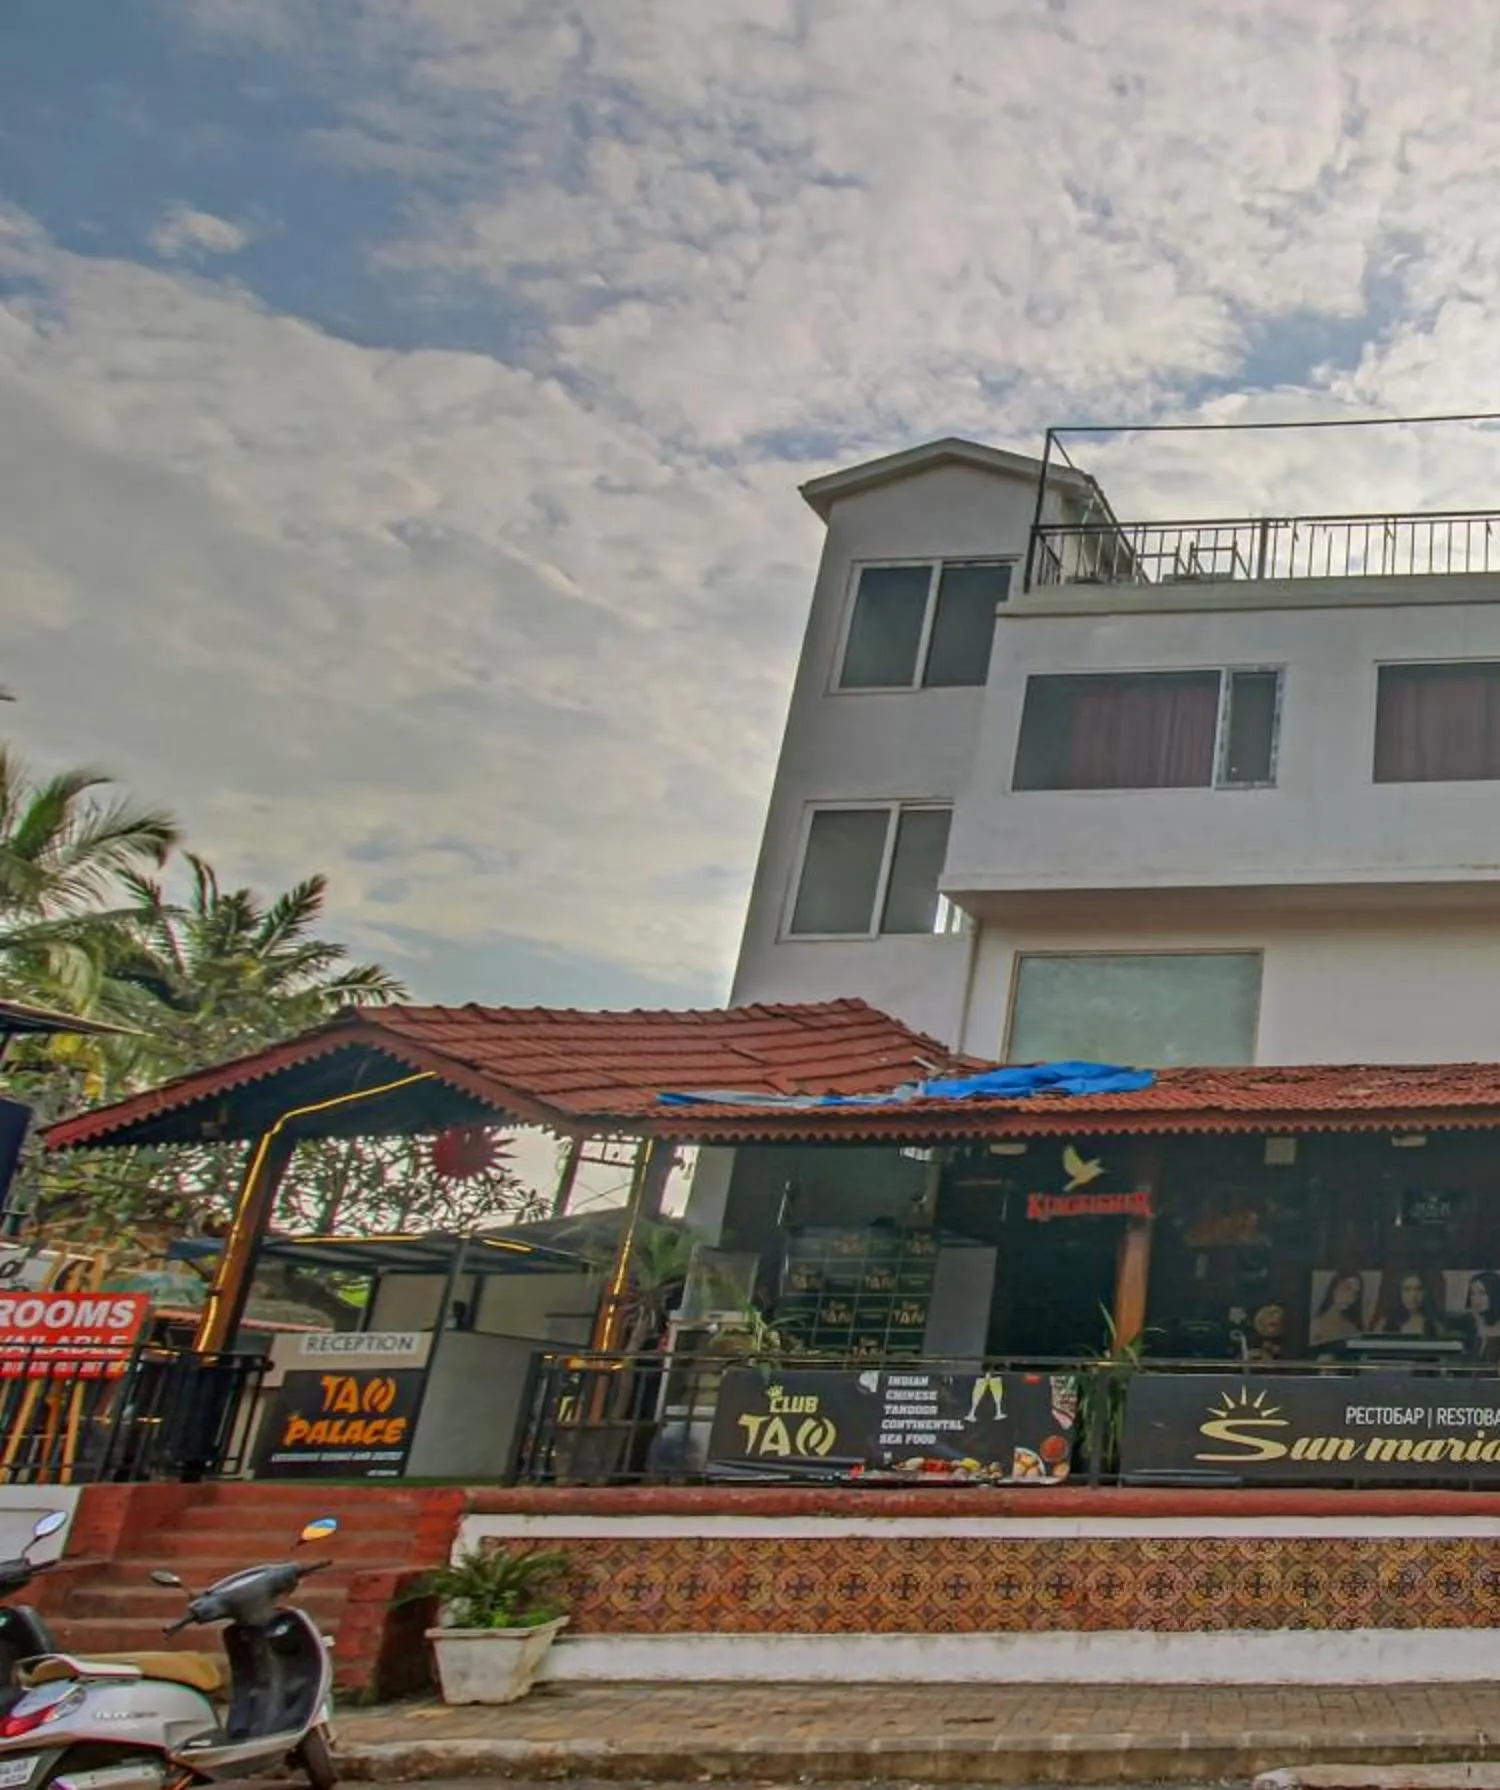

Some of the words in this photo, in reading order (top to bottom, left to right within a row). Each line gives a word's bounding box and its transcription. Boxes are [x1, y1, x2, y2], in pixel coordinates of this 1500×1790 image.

[306, 1335, 414, 1351] RECEPTION
[887, 1375, 929, 1386] INDIAN
[320, 1375, 397, 1414] TAO
[885, 1390, 938, 1401] CHINESE
[769, 1395, 819, 1413] CLUB
[884, 1405, 938, 1415] TANDOOR
[1345, 1406, 1424, 1426] РЕСТОБАР
[282, 1415, 407, 1446] PALACE
[881, 1419, 964, 1431] CONTINENTAL
[737, 1413, 837, 1457] TAO
[880, 1433, 902, 1445] SEA
[905, 1433, 936, 1445] FOOD
